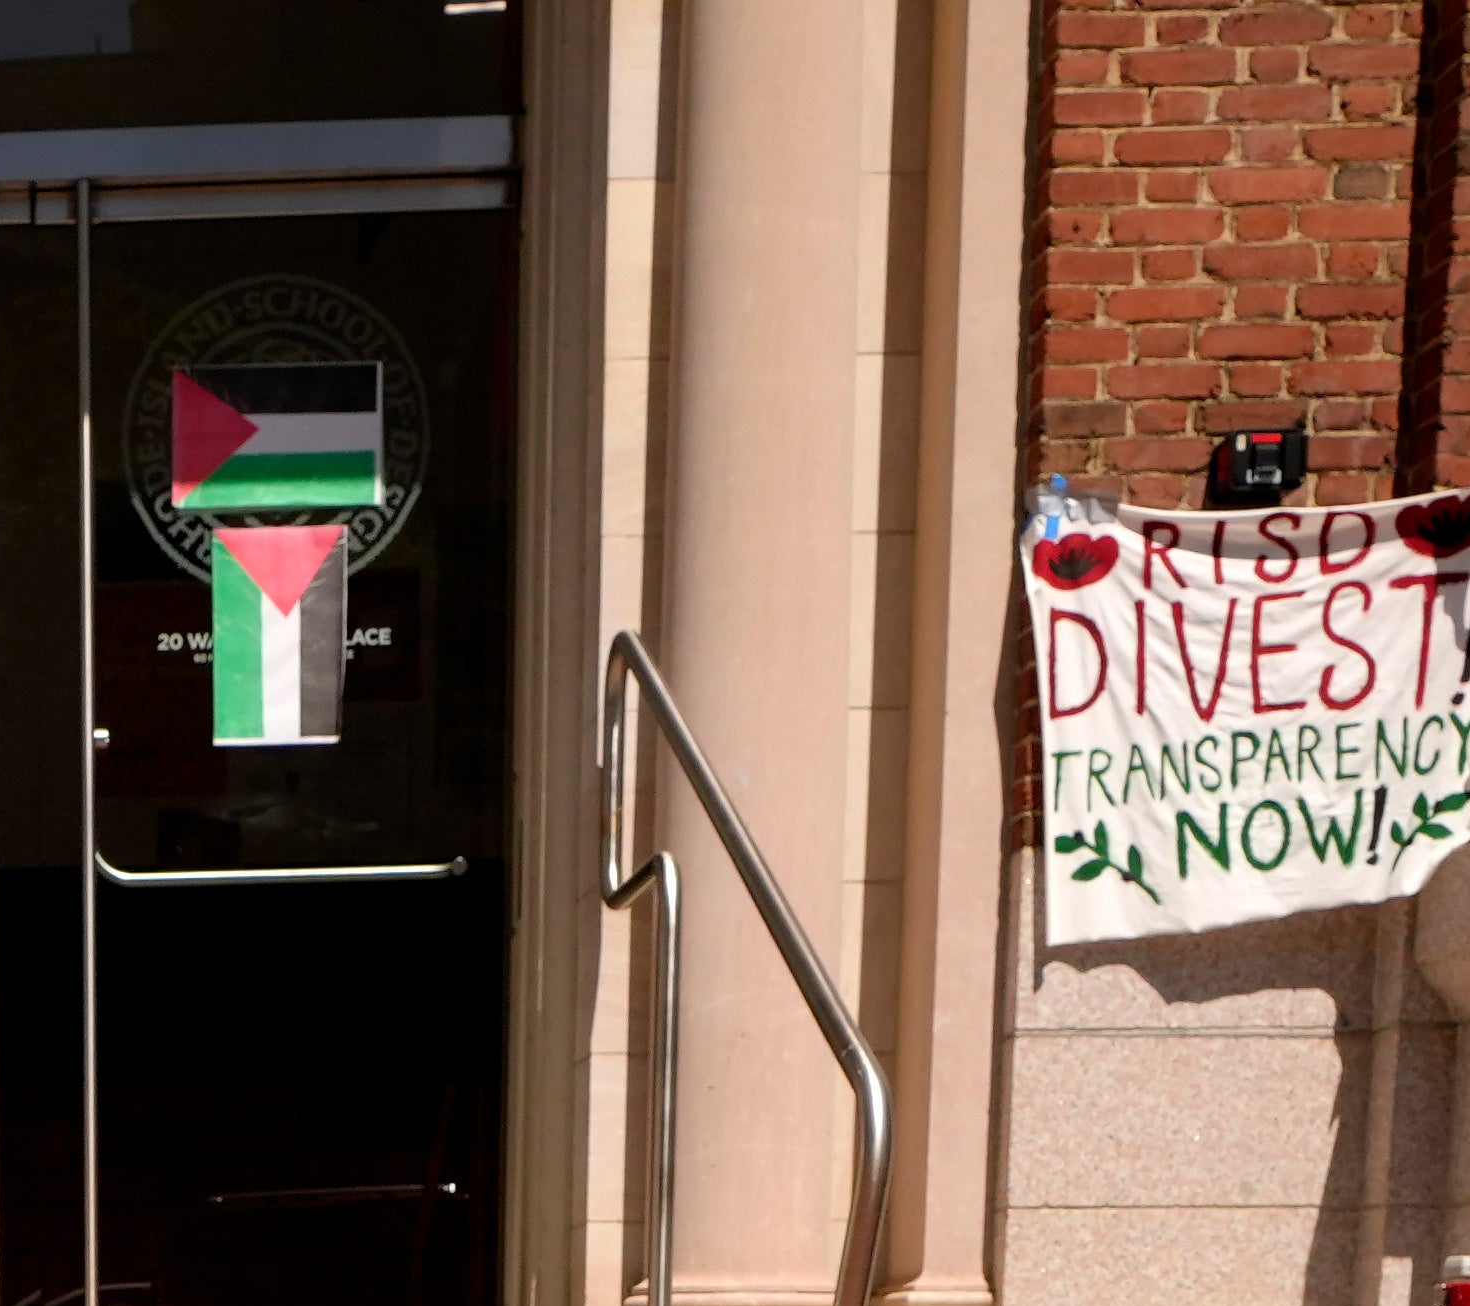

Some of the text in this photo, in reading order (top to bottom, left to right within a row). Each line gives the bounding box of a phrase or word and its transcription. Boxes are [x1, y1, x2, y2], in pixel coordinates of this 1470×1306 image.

[1141, 511, 1377, 590] RISD
[158, 633, 183, 651] 20
[1175, 785, 1388, 879] NOW!
